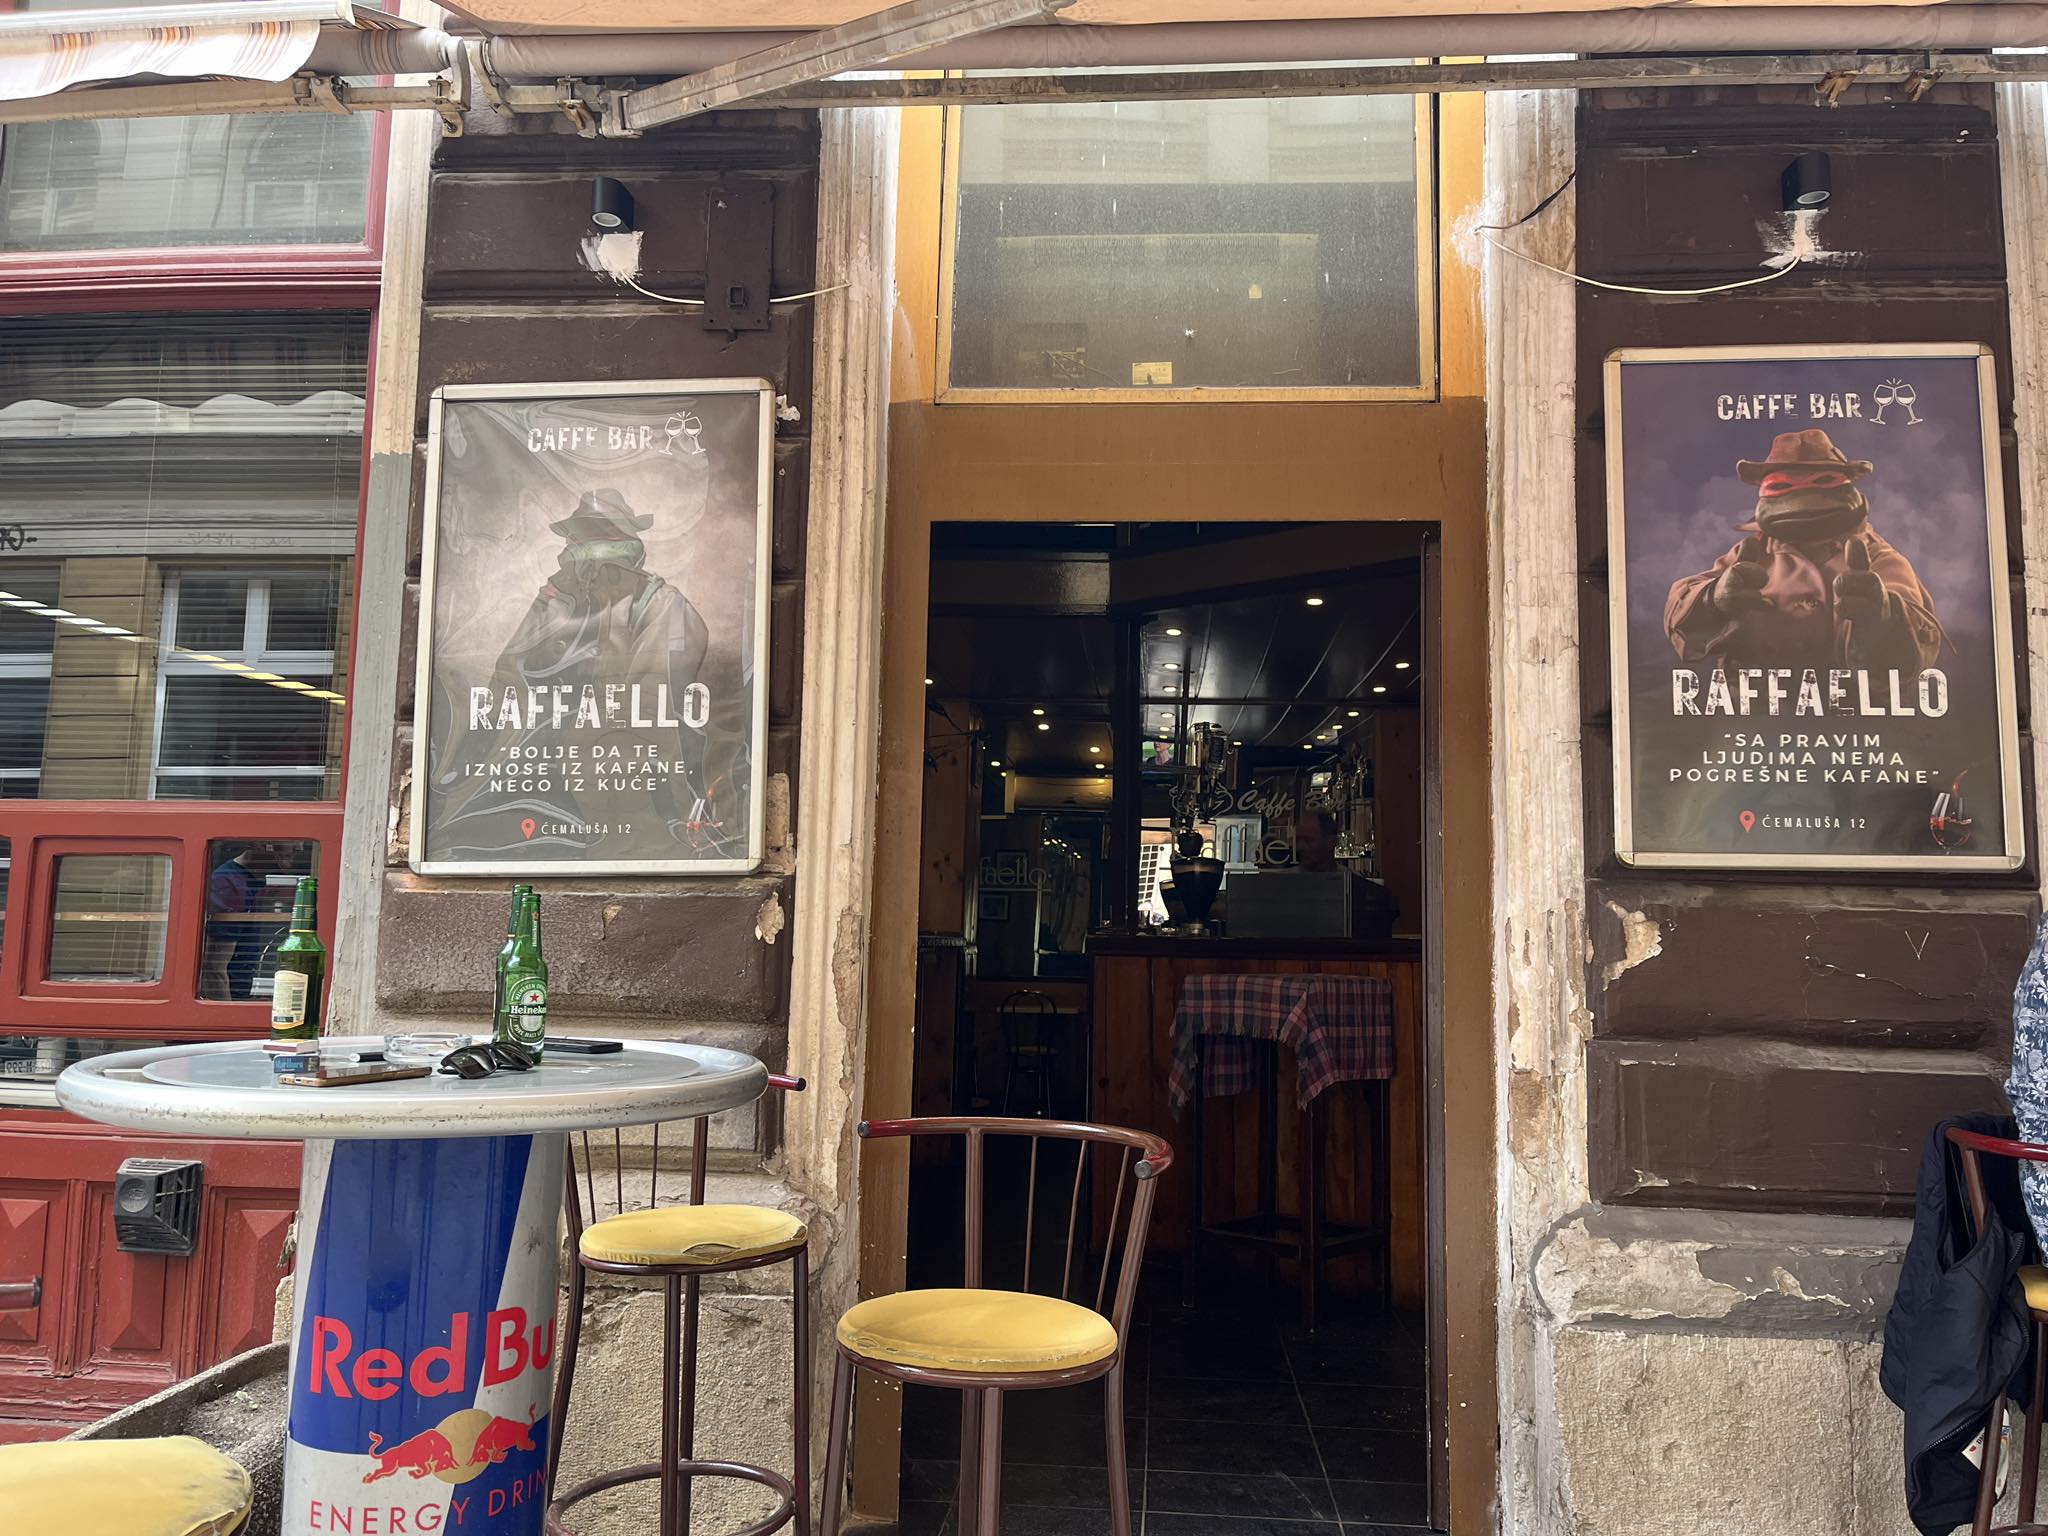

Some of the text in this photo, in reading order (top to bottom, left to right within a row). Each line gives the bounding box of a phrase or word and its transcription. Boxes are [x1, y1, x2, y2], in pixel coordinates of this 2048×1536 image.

[1717, 390, 1862, 421] CAFFE BAR
[528, 424, 654, 453] CAFFE BAR
[1671, 667, 1949, 718] RAFFAELLO
[469, 682, 710, 731] RAFFAELLO
[1779, 733, 1882, 748] PRAVIM
[592, 745, 621, 758] DA
[634, 745, 658, 757] TE
[1703, 749, 1905, 766] LJUDIMA NEMA
[465, 761, 694, 776] IZNOSE IZ KAFANE,
[1669, 763, 1809, 783] POGREŠNE
[490, 778, 552, 792] NEGO
[564, 778, 585, 792] IZ
[617, 823, 632, 834] 12
[1849, 818, 1866, 829] 12
[310, 1306, 556, 1401] Red Bu
[310, 1465, 548, 1535] ENERGY DRIN
